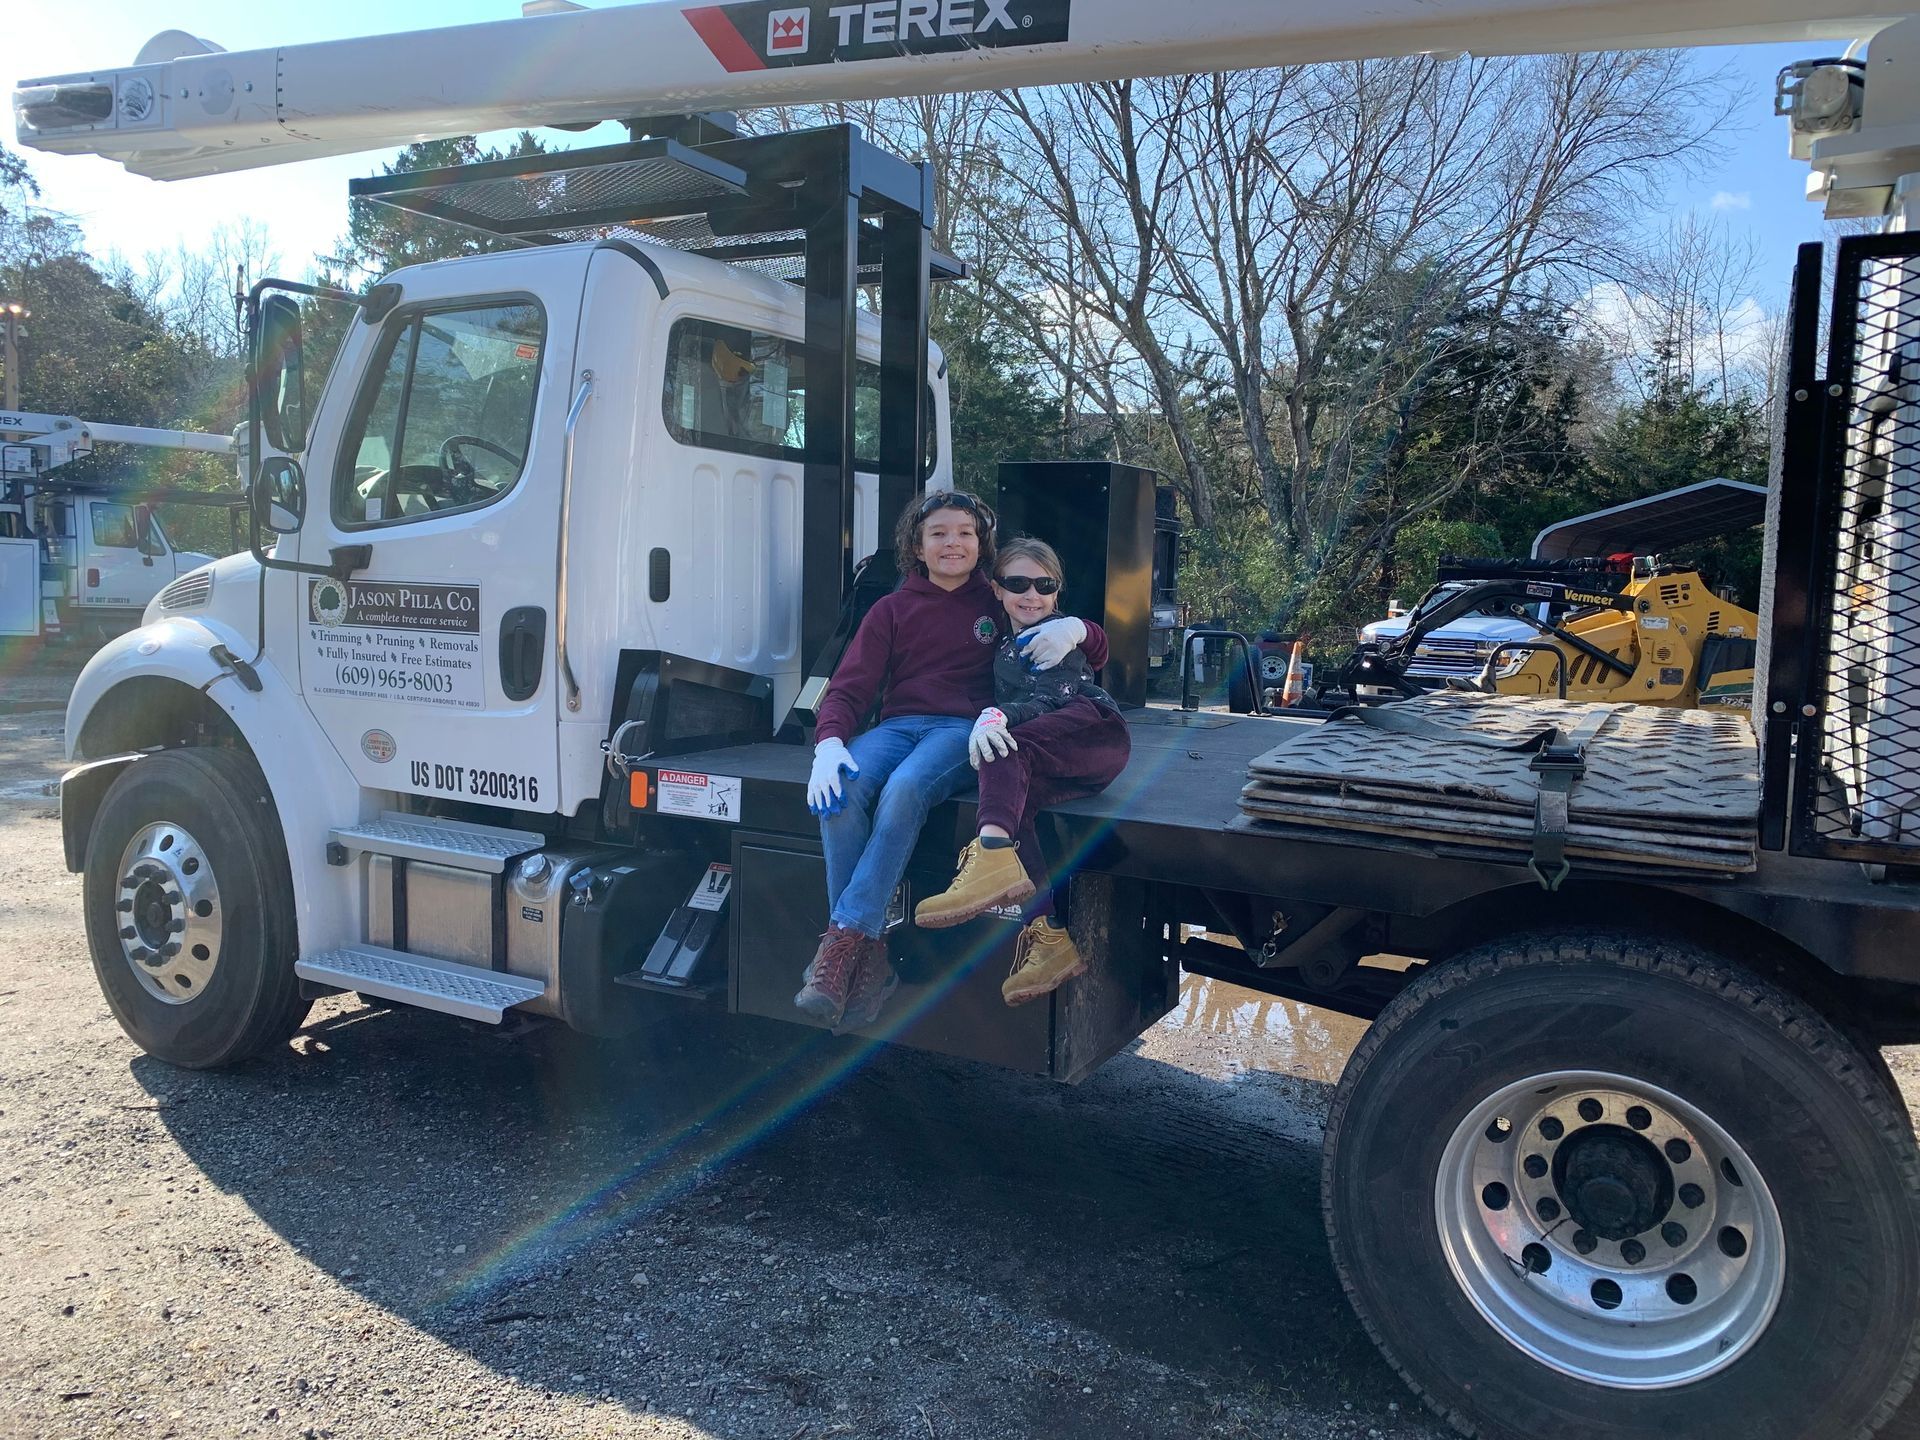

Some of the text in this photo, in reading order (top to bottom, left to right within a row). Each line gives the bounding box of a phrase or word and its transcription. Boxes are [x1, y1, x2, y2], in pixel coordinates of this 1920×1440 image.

[829, 0, 1018, 46] TEREX
[0, 417, 22, 426] EX
[350, 587, 395, 608] JASON
[399, 589, 443, 609] PILLA
[1564, 589, 1614, 606] Vermeer
[357, 611, 467, 627] A complete tree care service
[318, 630, 478, 652] Trimming Pruning Removals
[326, 647, 472, 669] Fully Insured Free Estimates
[378, 668, 453, 693] 965-8003
[411, 761, 538, 803] US DOT 3200316
[669, 773, 705, 786] DANGER
